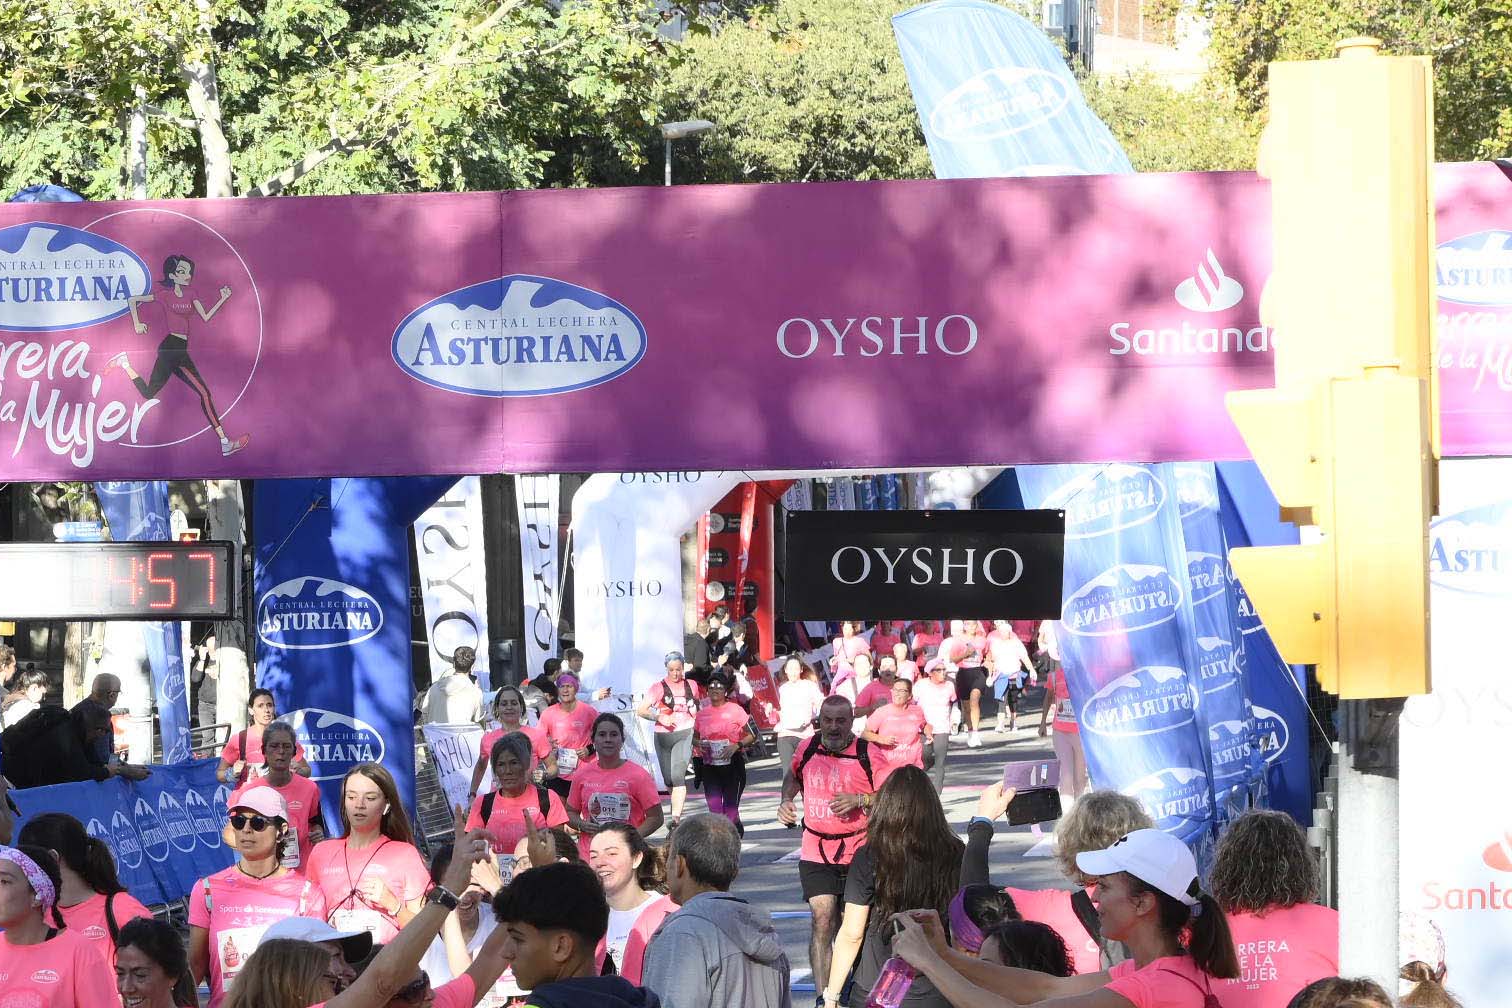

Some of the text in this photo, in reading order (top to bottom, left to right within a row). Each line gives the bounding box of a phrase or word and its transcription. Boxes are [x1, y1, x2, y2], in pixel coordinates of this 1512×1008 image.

[54, 258, 125, 270] LECHERA
[450, 315, 619, 331] CENTRAL LECHERA
[776, 314, 979, 358] OYSHO
[412, 323, 627, 367] ASTURIANA
[12, 375, 161, 468] Mujer
[831, 546, 1024, 587] OYSHO
[273, 601, 369, 610] CENTRAL LECHERA
[261, 606, 374, 634] ASTURIANA
[321, 733, 370, 742] LECHERA
[1254, 954, 1274, 968] LA
[1227, 968, 1278, 985] MUJER
